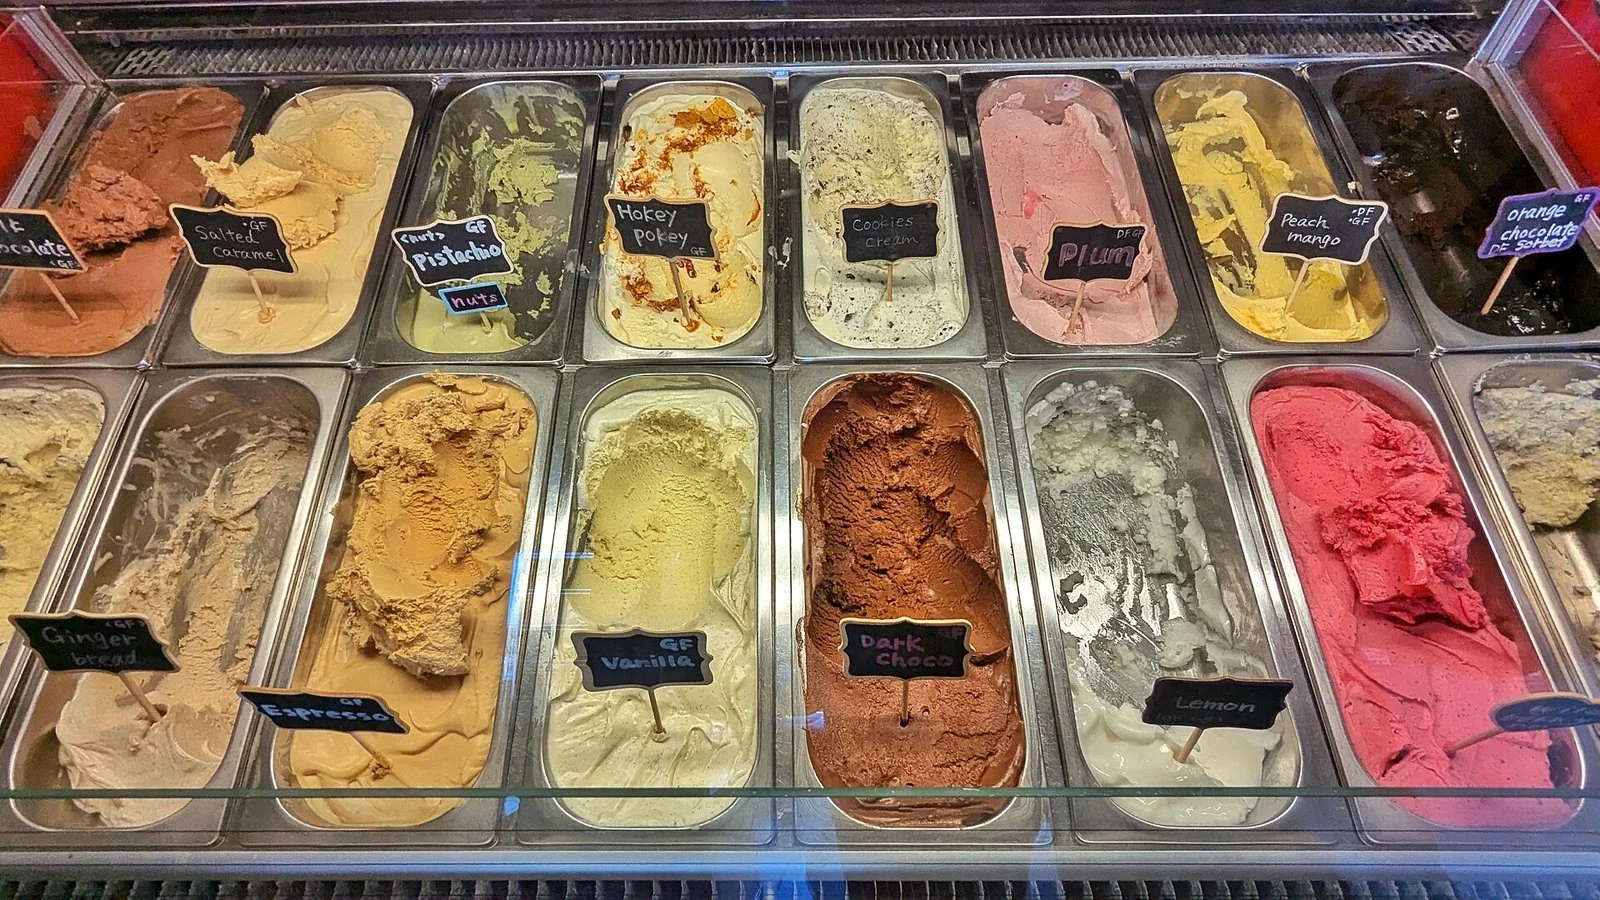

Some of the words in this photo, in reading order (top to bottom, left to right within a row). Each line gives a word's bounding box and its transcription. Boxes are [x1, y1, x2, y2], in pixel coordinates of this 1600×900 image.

[617, 204, 677, 227] Hokey
[1280, 213, 1330, 229] Peach
[1507, 204, 1567, 222] orange
[465, 220, 487, 234] GF
[852, 215, 914, 232] Cookies
[1500, 221, 1579, 241] chocolate
[195, 225, 260, 244] Salted
[1287, 232, 1341, 249] mango
[1515, 235, 1568, 251] sorbet
[0, 239, 71, 257] ocolate
[212, 246, 284, 263] caramel
[412, 241, 502, 271] Pistachio
[690, 247, 707, 256] GF
[1058, 242, 1135, 267] Plum
[451, 293, 498, 308] nuts
[41, 626, 137, 650] Ginger
[659, 638, 694, 652] GF
[860, 633, 925, 653] Dark
[70, 650, 136, 667] bread
[340, 698, 363, 706] GF
[1175, 696, 1257, 713] Lemon
[260, 704, 390, 721] Espresso
